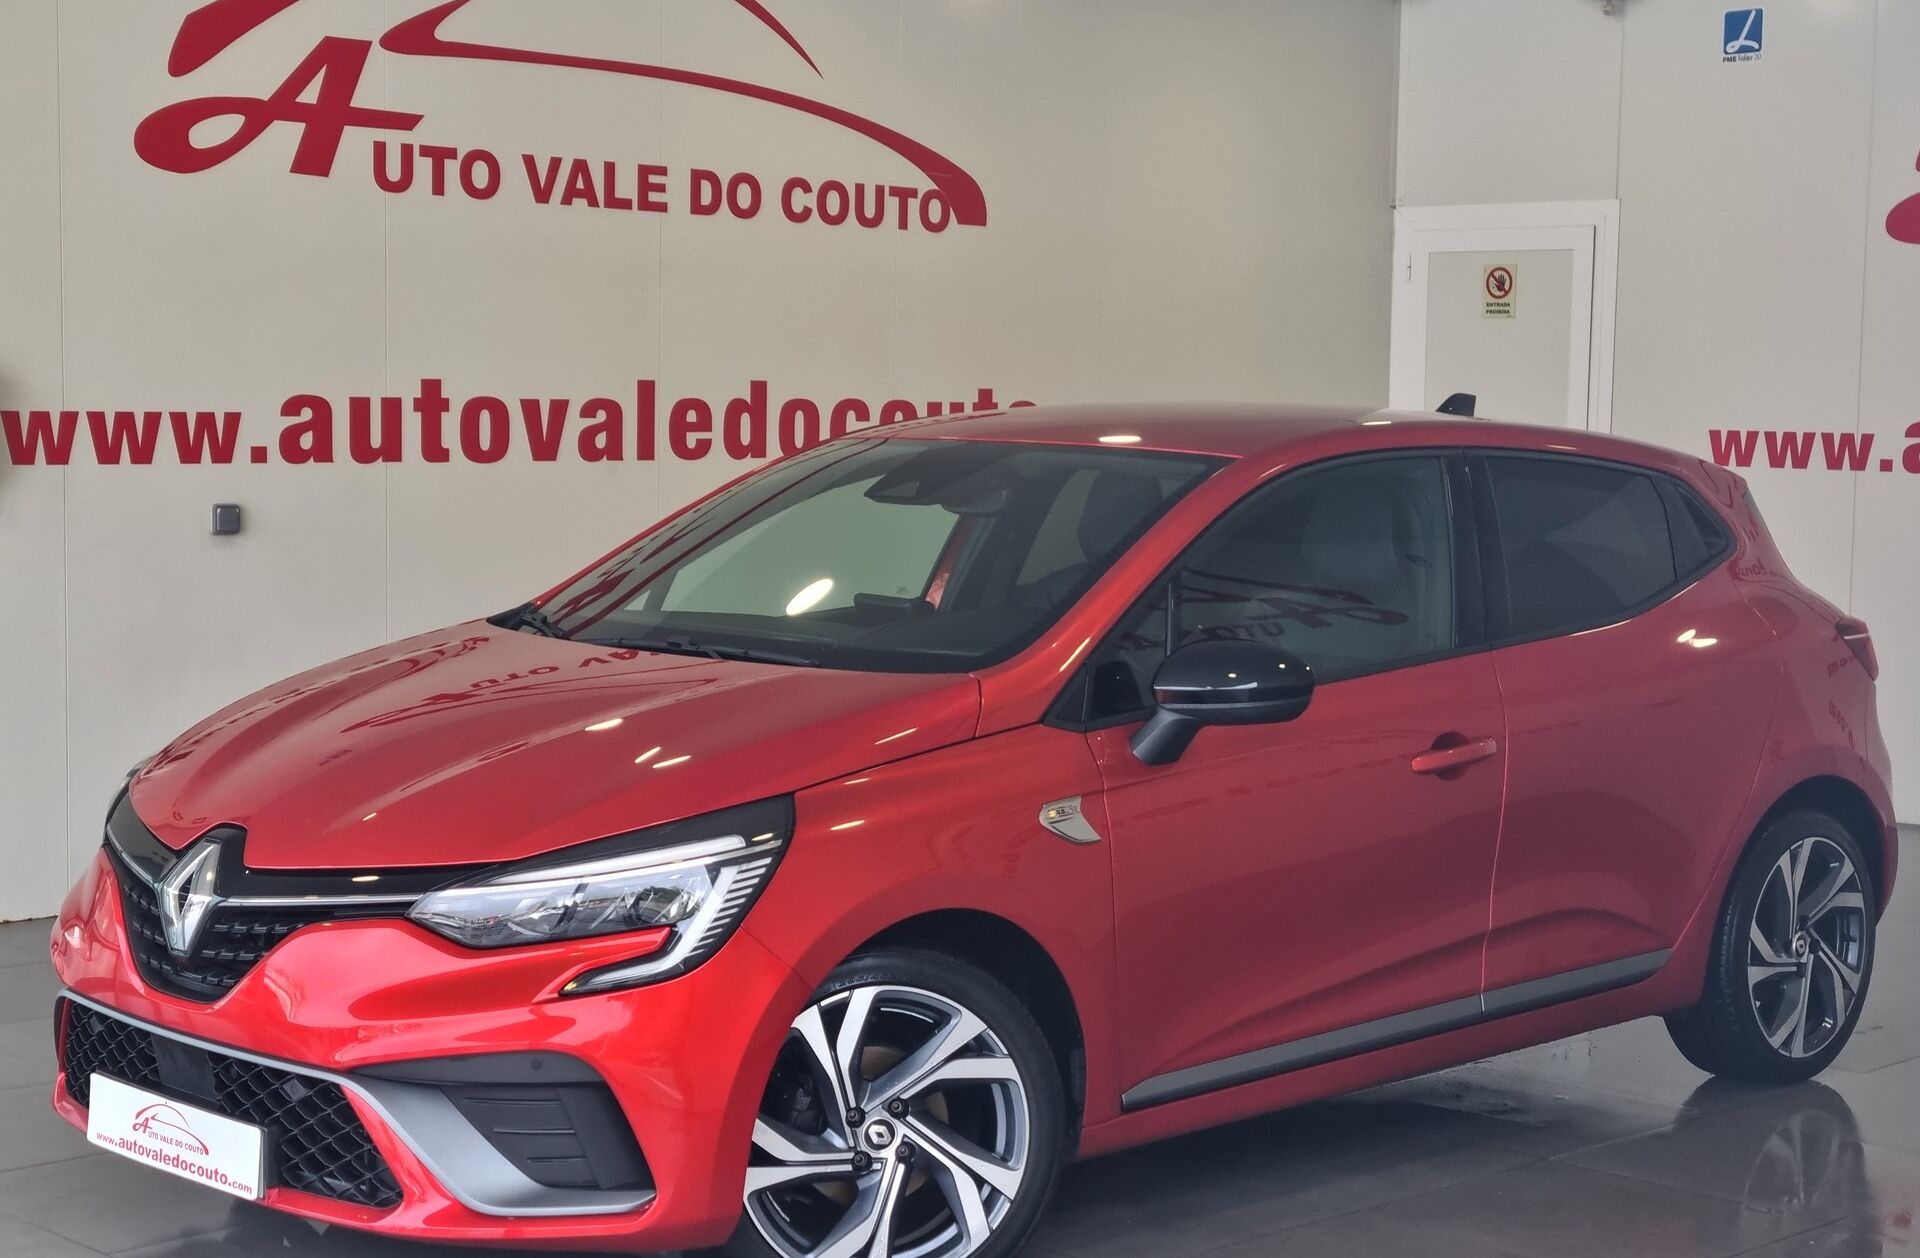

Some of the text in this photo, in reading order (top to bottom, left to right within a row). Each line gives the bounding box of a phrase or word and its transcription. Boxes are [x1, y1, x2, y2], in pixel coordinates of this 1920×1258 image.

[522, 154, 668, 213] VALE
[690, 168, 762, 219] DO
[781, 177, 951, 233] COUTO
[3, 379, 1037, 465] www.autovaledoc
[96, 1131, 253, 1195] www.autovaledocouto.com
[160, 1135, 174, 1147] VALE
[175, 1139, 184, 1149] DO
[184, 1142, 204, 1156] COUTO
